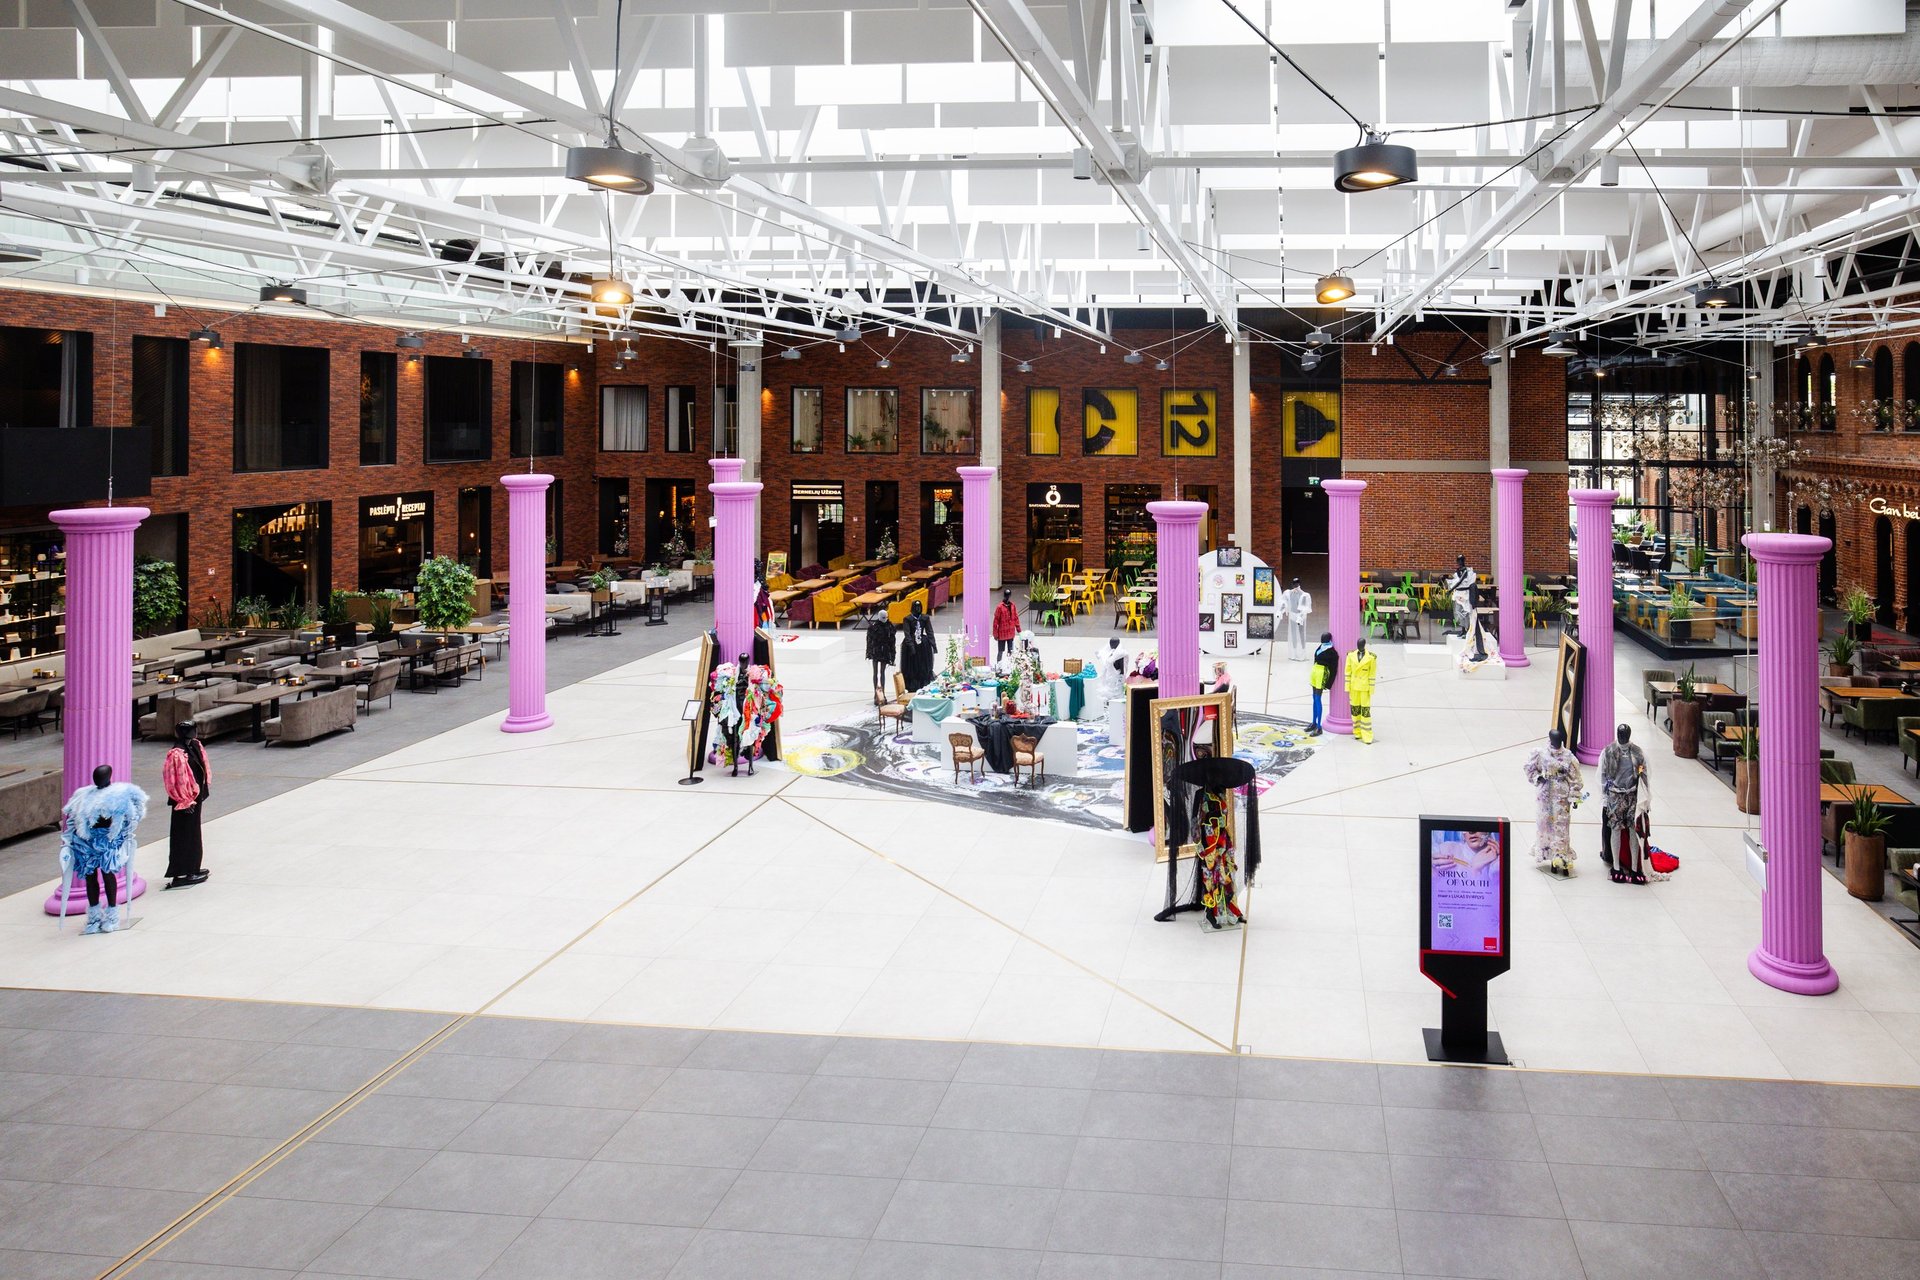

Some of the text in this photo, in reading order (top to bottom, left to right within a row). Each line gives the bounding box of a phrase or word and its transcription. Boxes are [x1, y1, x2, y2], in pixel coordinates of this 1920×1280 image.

[1170, 392, 1210, 449] 12
[1870, 497, 1920, 520] Gan bei
[1438, 870, 1468, 878] SPRING
[1446, 879, 1490, 888] OF YOUTH
